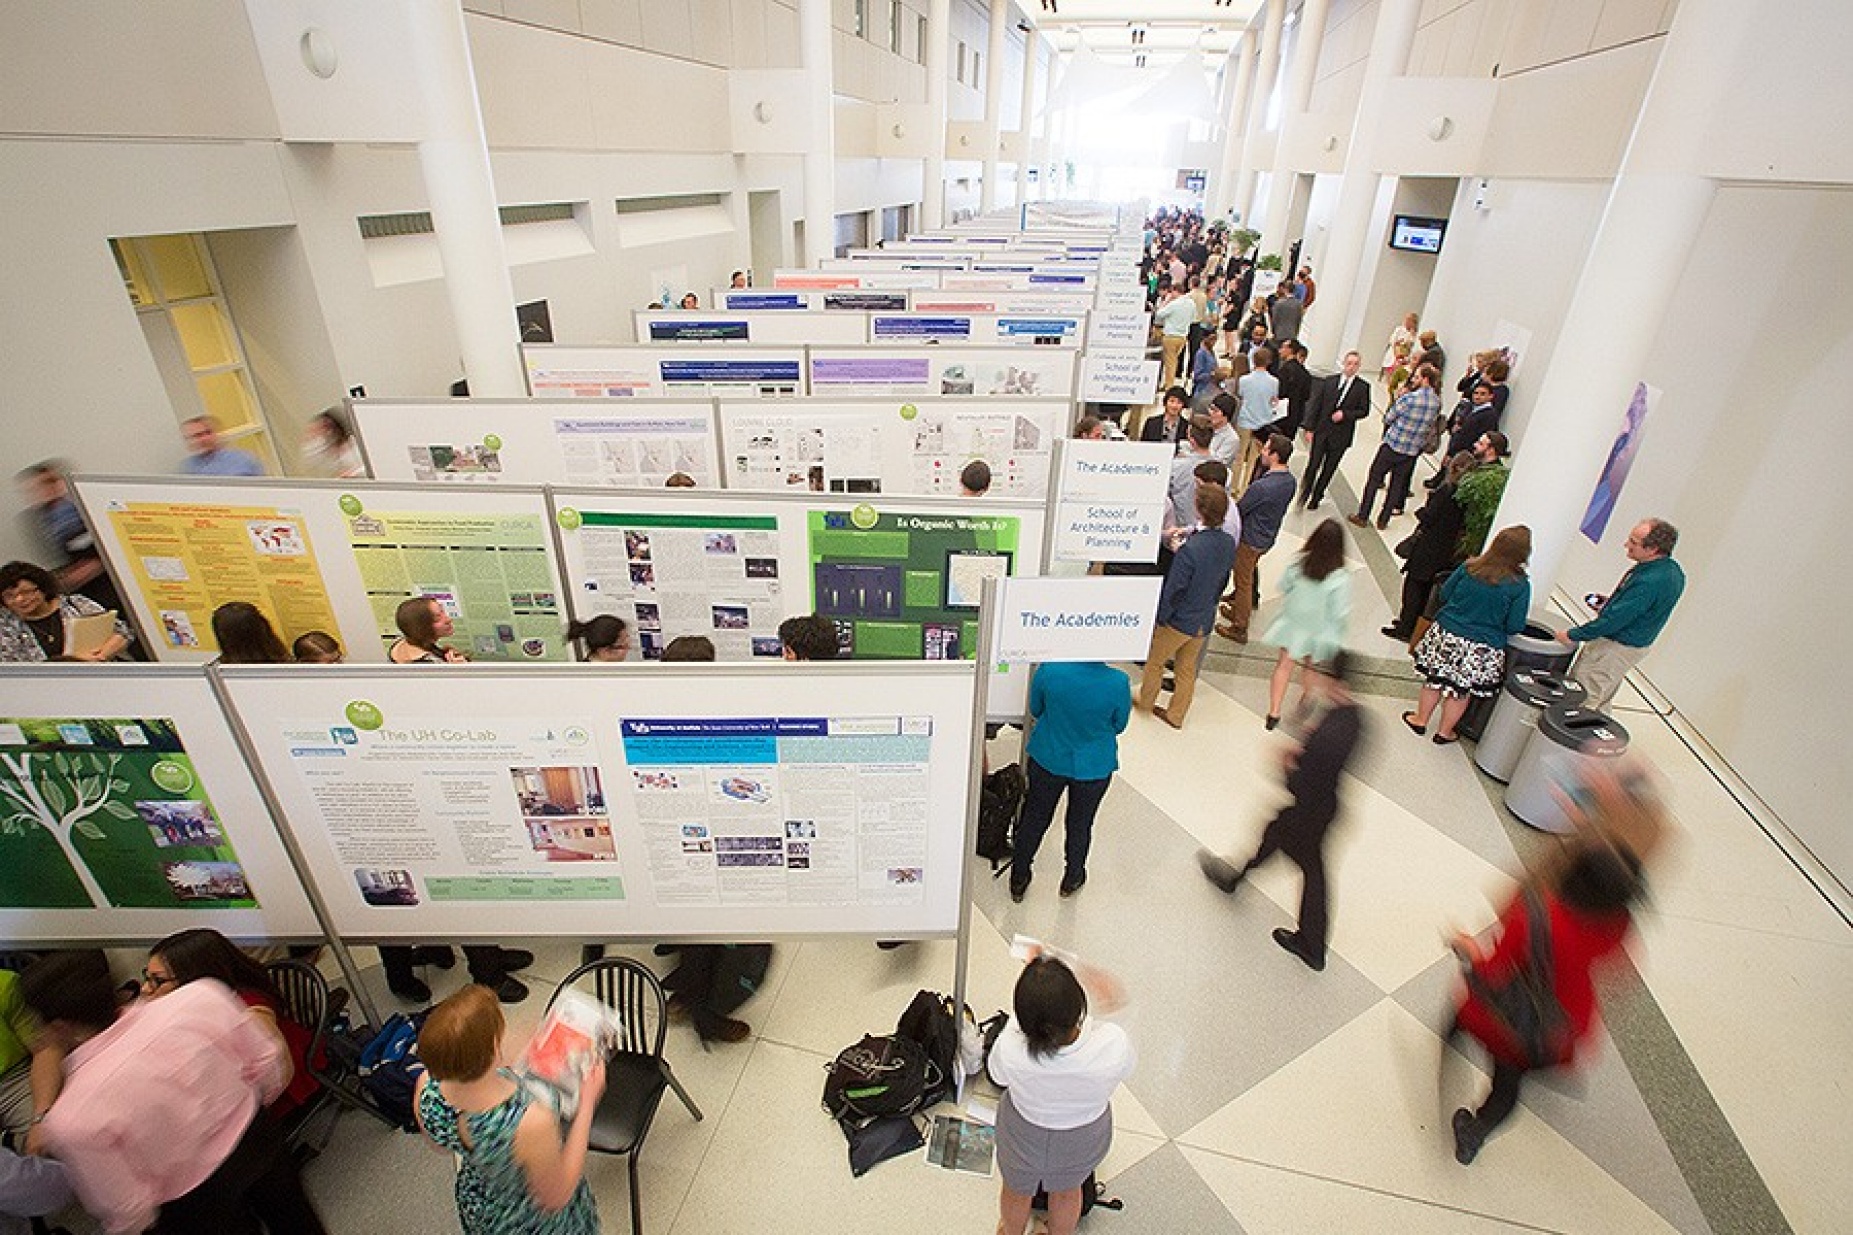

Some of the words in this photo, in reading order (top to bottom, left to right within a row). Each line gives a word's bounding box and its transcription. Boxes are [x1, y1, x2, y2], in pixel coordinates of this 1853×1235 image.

[1105, 362, 1130, 371] School
[1132, 363, 1142, 371] of
[1093, 374, 1141, 383] Architecture
[1142, 375, 1150, 384] &
[1103, 385, 1136, 395] Planning
[1077, 461, 1098, 474] The
[1100, 463, 1160, 475] Academies
[1087, 507, 1124, 518] School
[1126, 508, 1138, 519] of
[897, 516, 908, 528] Is
[910, 516, 954, 531] Organic
[956, 519, 990, 531] Worth
[1070, 523, 1139, 534] Architecture
[1141, 523, 1150, 535] &
[1085, 536, 1132, 550] Planning
[1020, 611, 1051, 628] The
[1054, 611, 1140, 628] Academies
[379, 729, 409, 742] The
[412, 729, 437, 742] UH
[440, 729, 497, 743] Co-Lab
